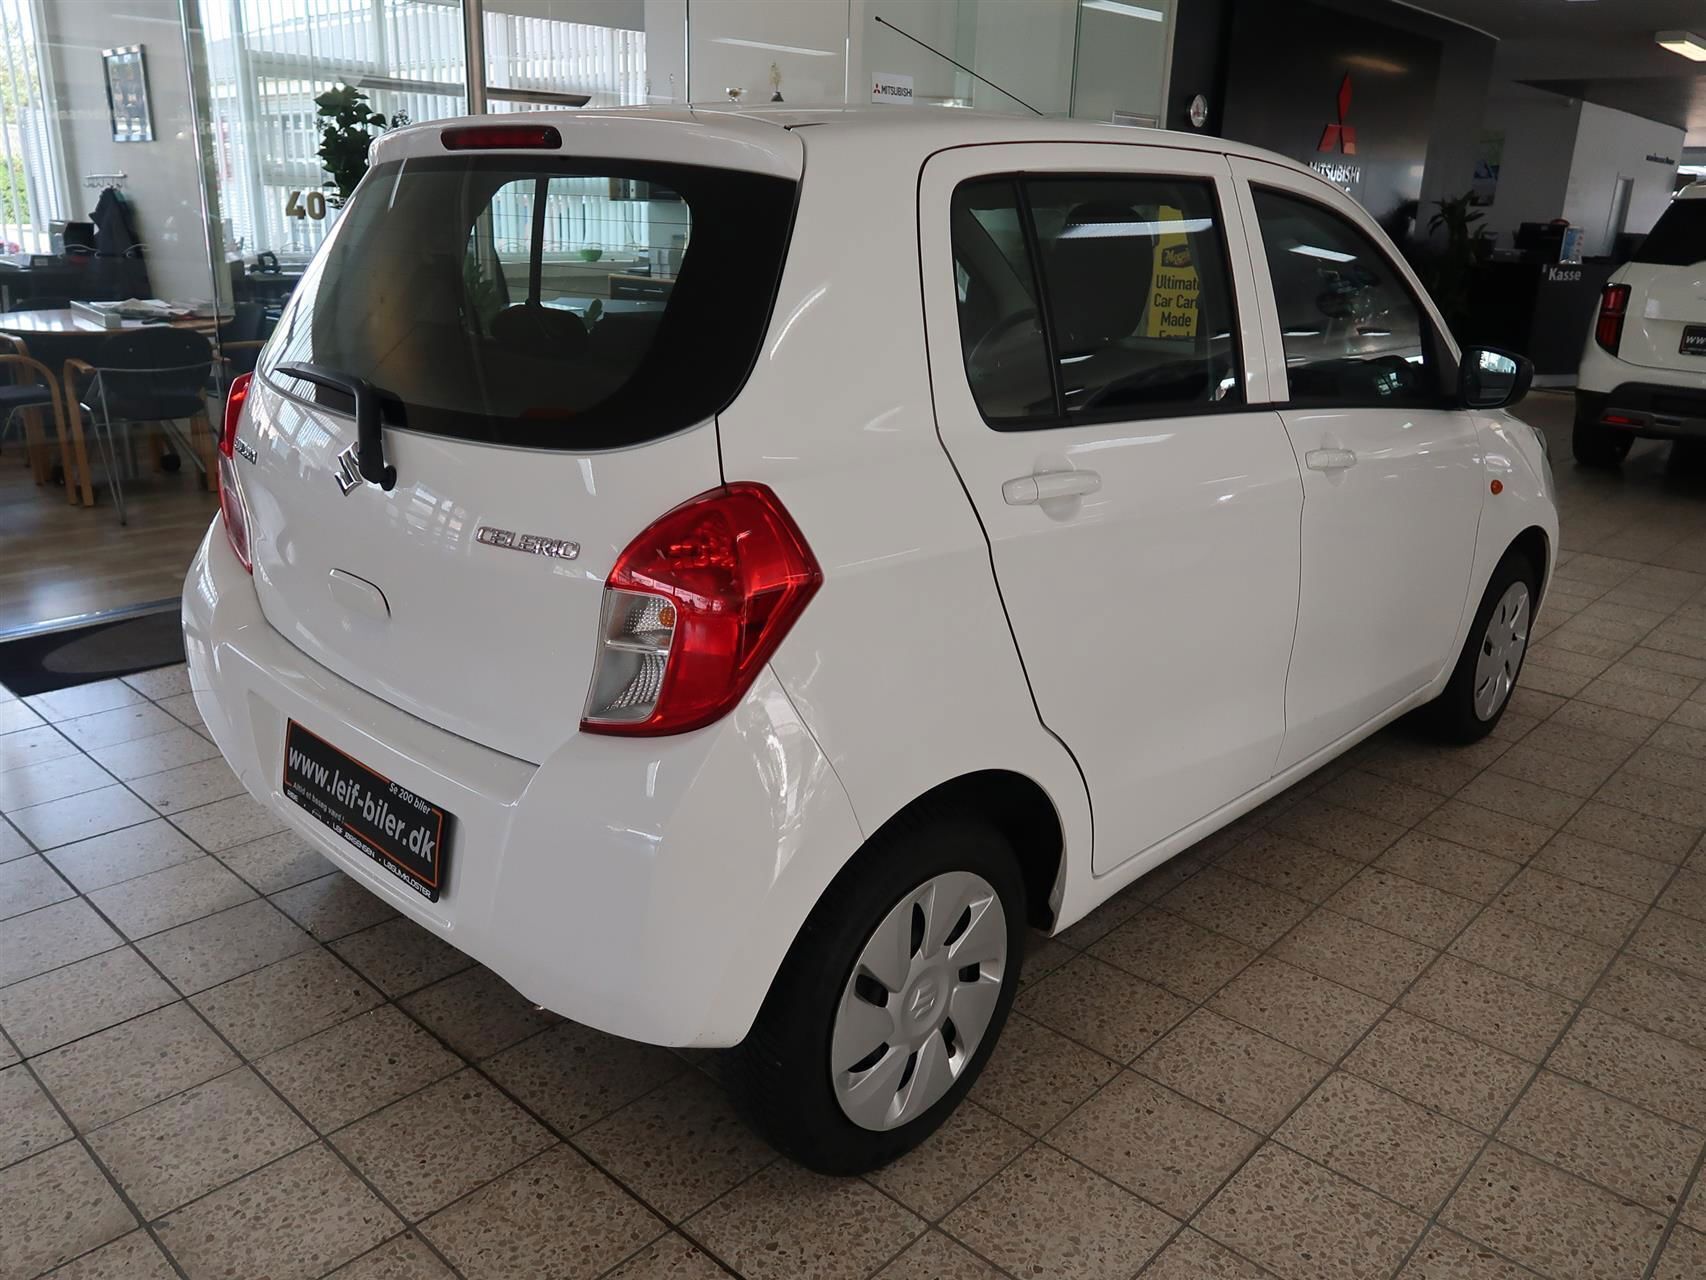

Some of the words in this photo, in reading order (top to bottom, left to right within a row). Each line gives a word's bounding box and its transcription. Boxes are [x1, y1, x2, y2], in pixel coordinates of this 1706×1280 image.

[881, 85, 912, 97] MITSUBISHI
[285, 191, 326, 220] 40
[1548, 267, 1582, 281] Kasse
[1154, 293, 1173, 308] Car
[1160, 311, 1191, 327] Made
[475, 526, 581, 560] CELERIO
[288, 746, 436, 863] www.leif-biler.dk
[388, 782, 398, 795] Se
[398, 788, 414, 804] 200
[413, 797, 431, 815] biler
